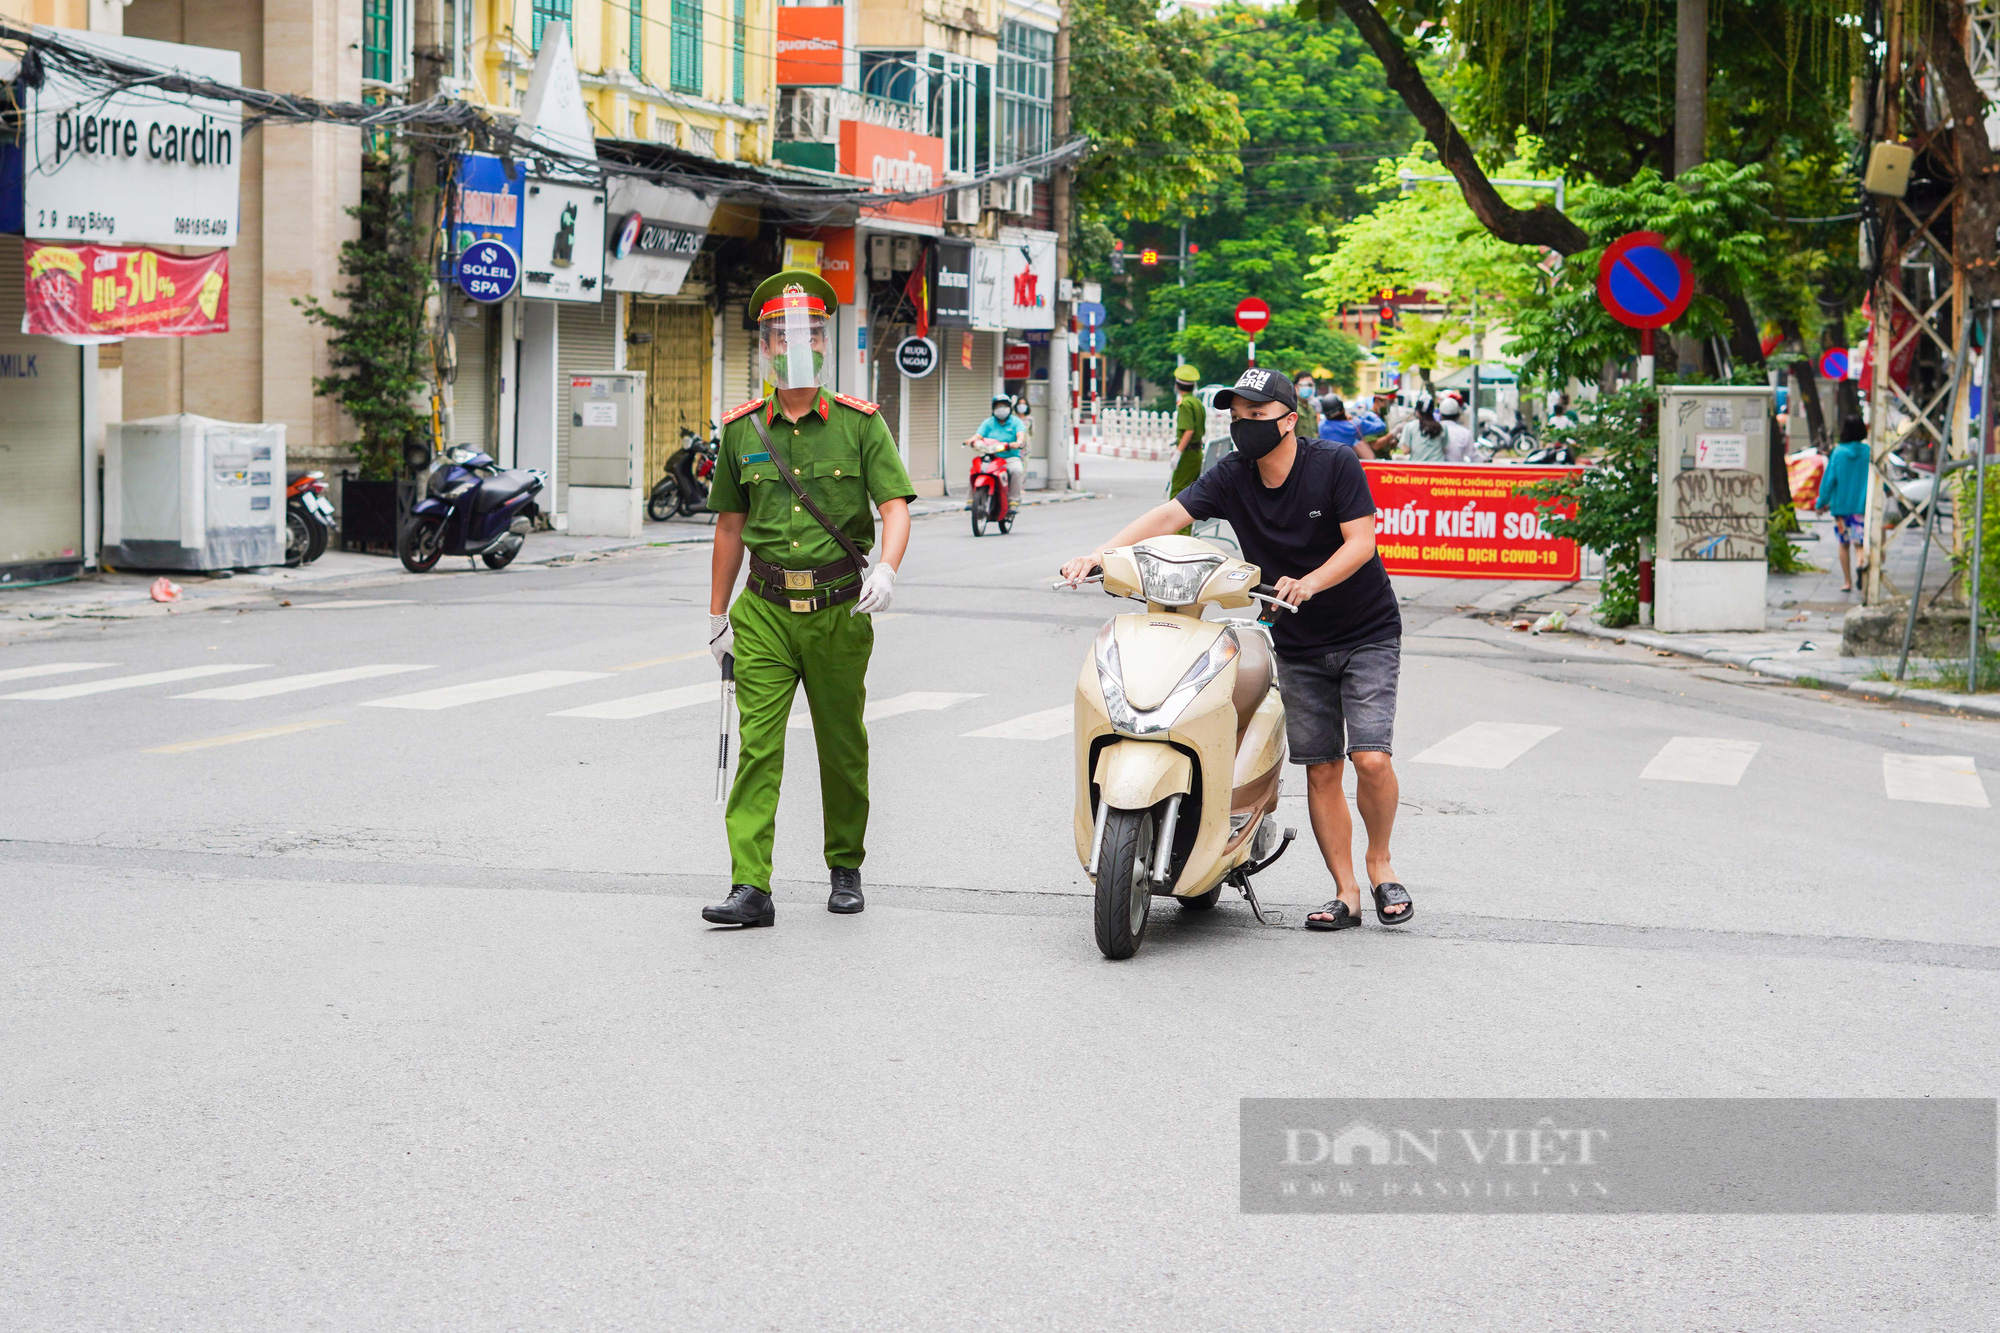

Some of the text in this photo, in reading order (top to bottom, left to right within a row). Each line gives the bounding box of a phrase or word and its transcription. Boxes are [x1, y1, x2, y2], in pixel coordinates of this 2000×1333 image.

[776, 37, 838, 53] guardian
[56, 102, 231, 165] pierre cardin
[1142, 251, 1157, 264] 23
[462, 264, 512, 279] SOLEIL
[470, 280, 501, 295] SPA
[1381, 289, 1394, 300] 23
[0, 354, 38, 378] MILK
[1410, 476, 1428, 485] HUY
[1374, 500, 1429, 536] CHỐT
[1436, 501, 1496, 538] KIỂM
[1377, 542, 1557, 565] PHÒNG CHỐNG DỊCH COVID-19
